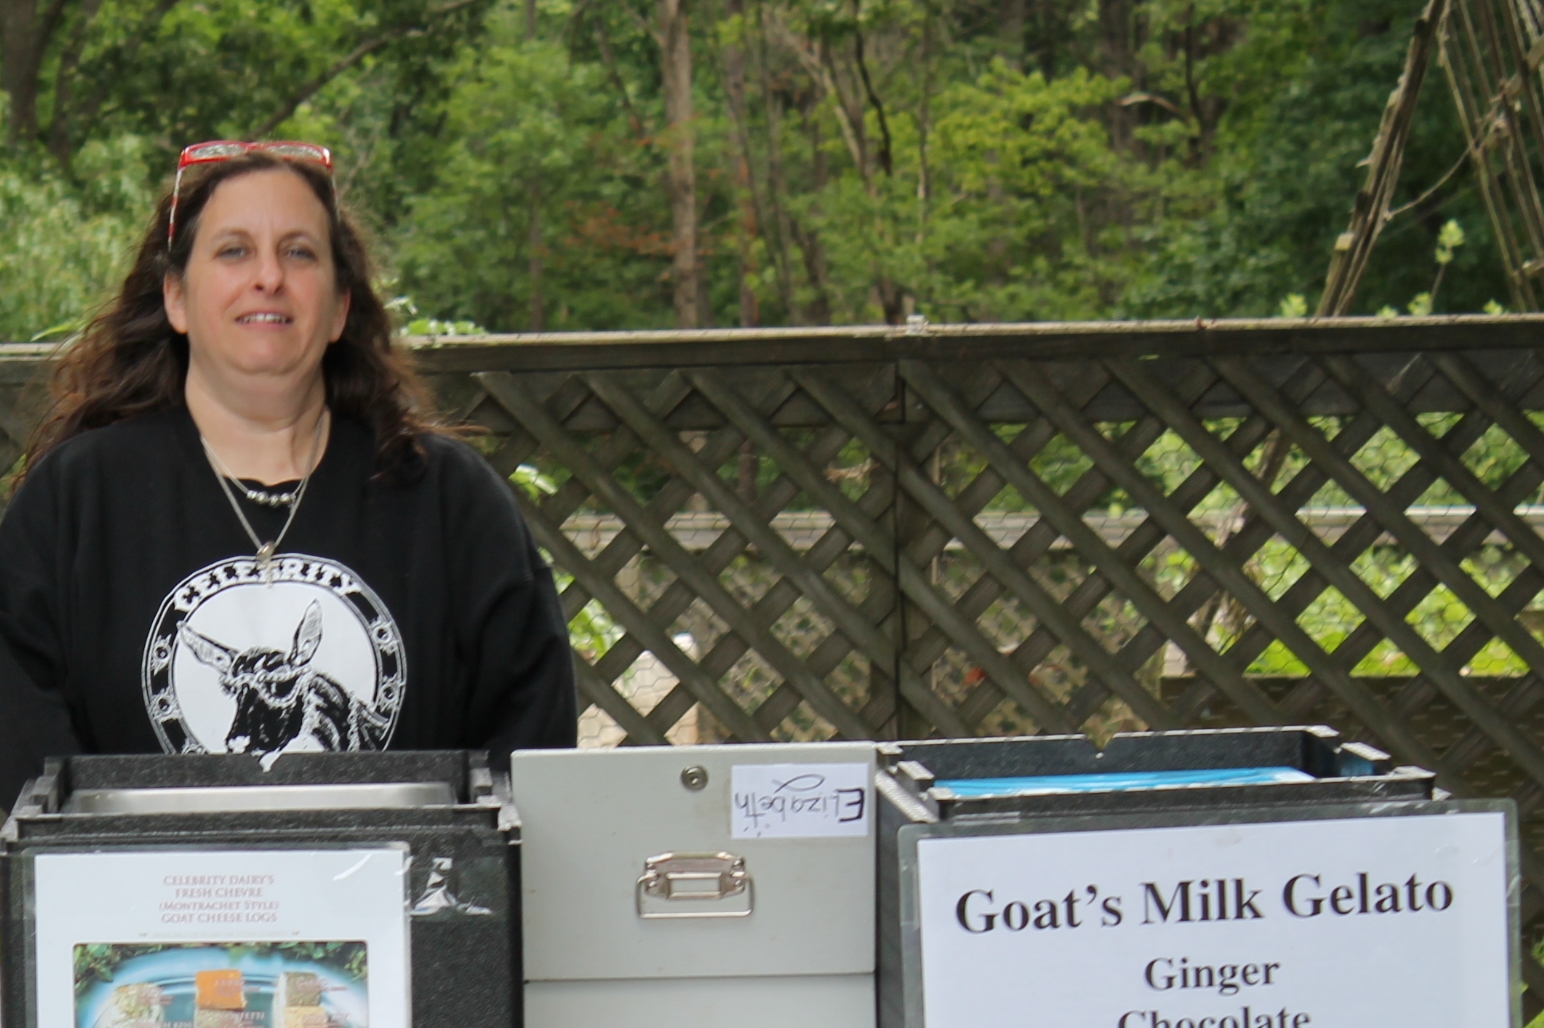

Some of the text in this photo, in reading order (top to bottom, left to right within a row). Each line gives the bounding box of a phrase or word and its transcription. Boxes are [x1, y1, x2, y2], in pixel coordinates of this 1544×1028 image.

[734, 787, 865, 829] Elizabeth
[162, 874, 275, 886] CELEBRITY DAIRY'S
[175, 887, 264, 898] FRESH CHEVRE
[955, 871, 1454, 934] Goat's Milk Gelato
[160, 911, 278, 923] GOAT CHEESE LOGS
[1144, 957, 1280, 996] Ginger
